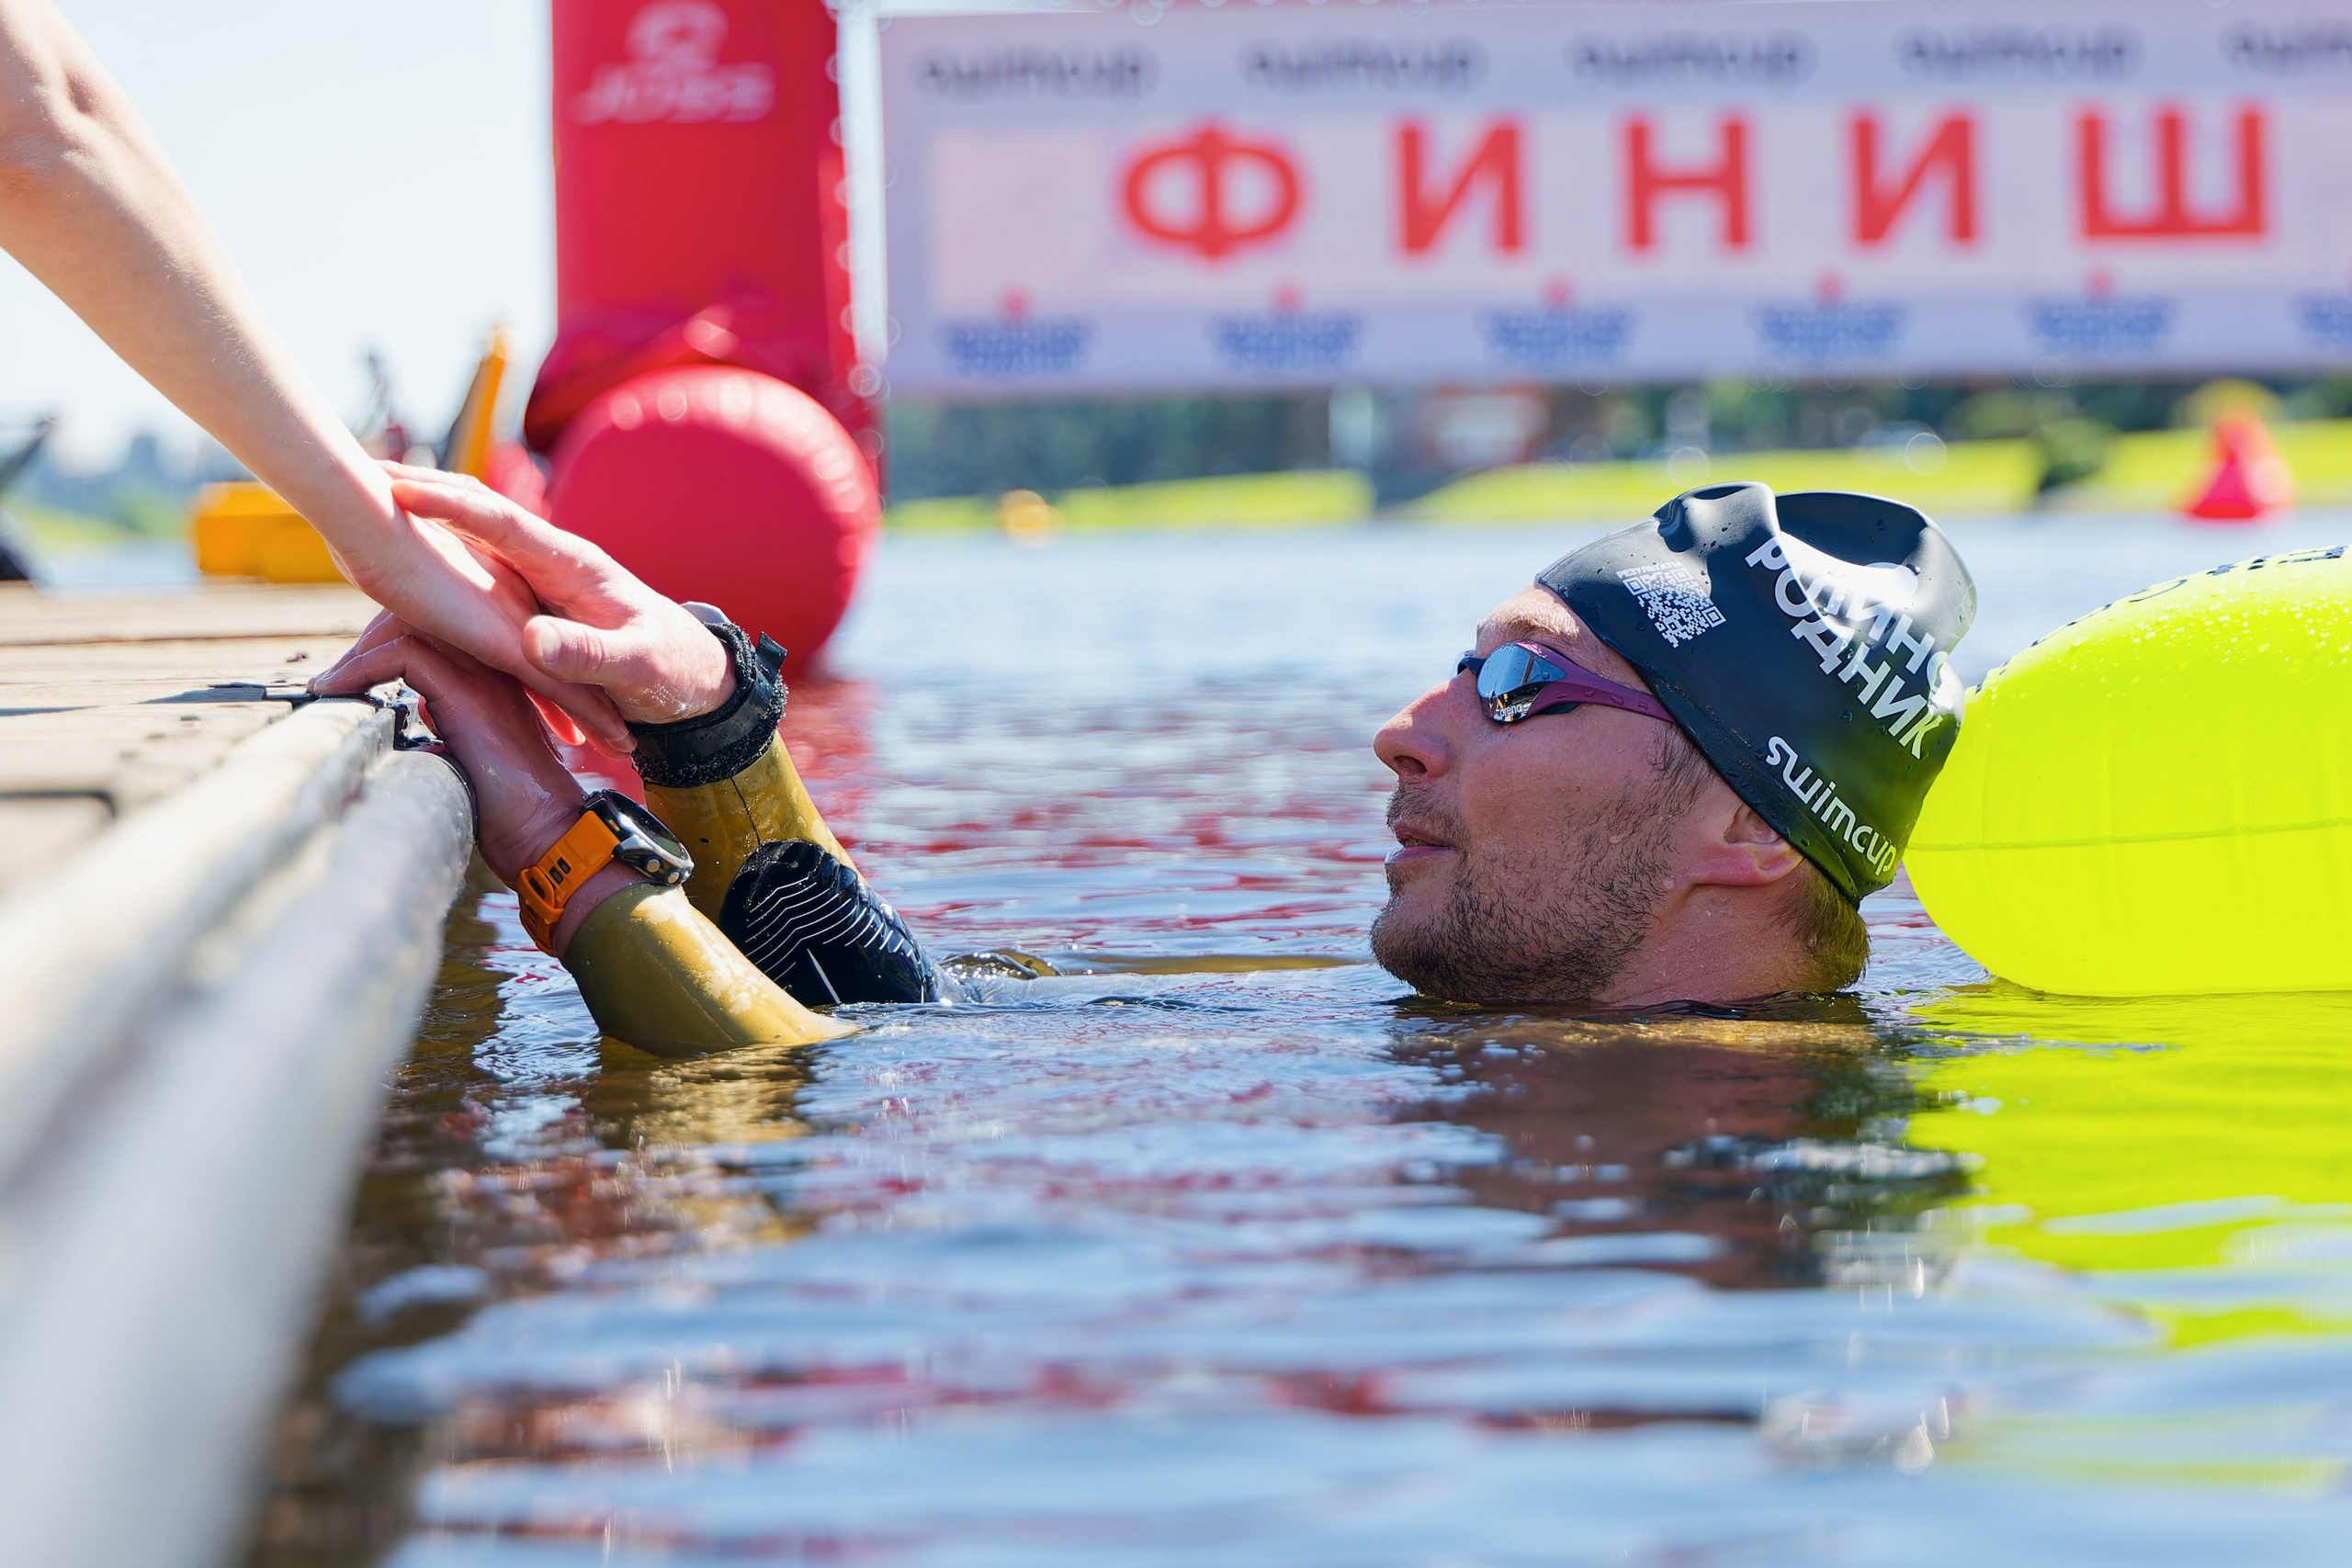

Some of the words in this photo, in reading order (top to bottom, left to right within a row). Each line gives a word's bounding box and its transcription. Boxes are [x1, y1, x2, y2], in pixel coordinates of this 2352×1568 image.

[1116, 107, 2269, 262] ФИНИШ
[1745, 536, 1943, 760] РОДНИК
[1765, 736, 1897, 876] swimcup
